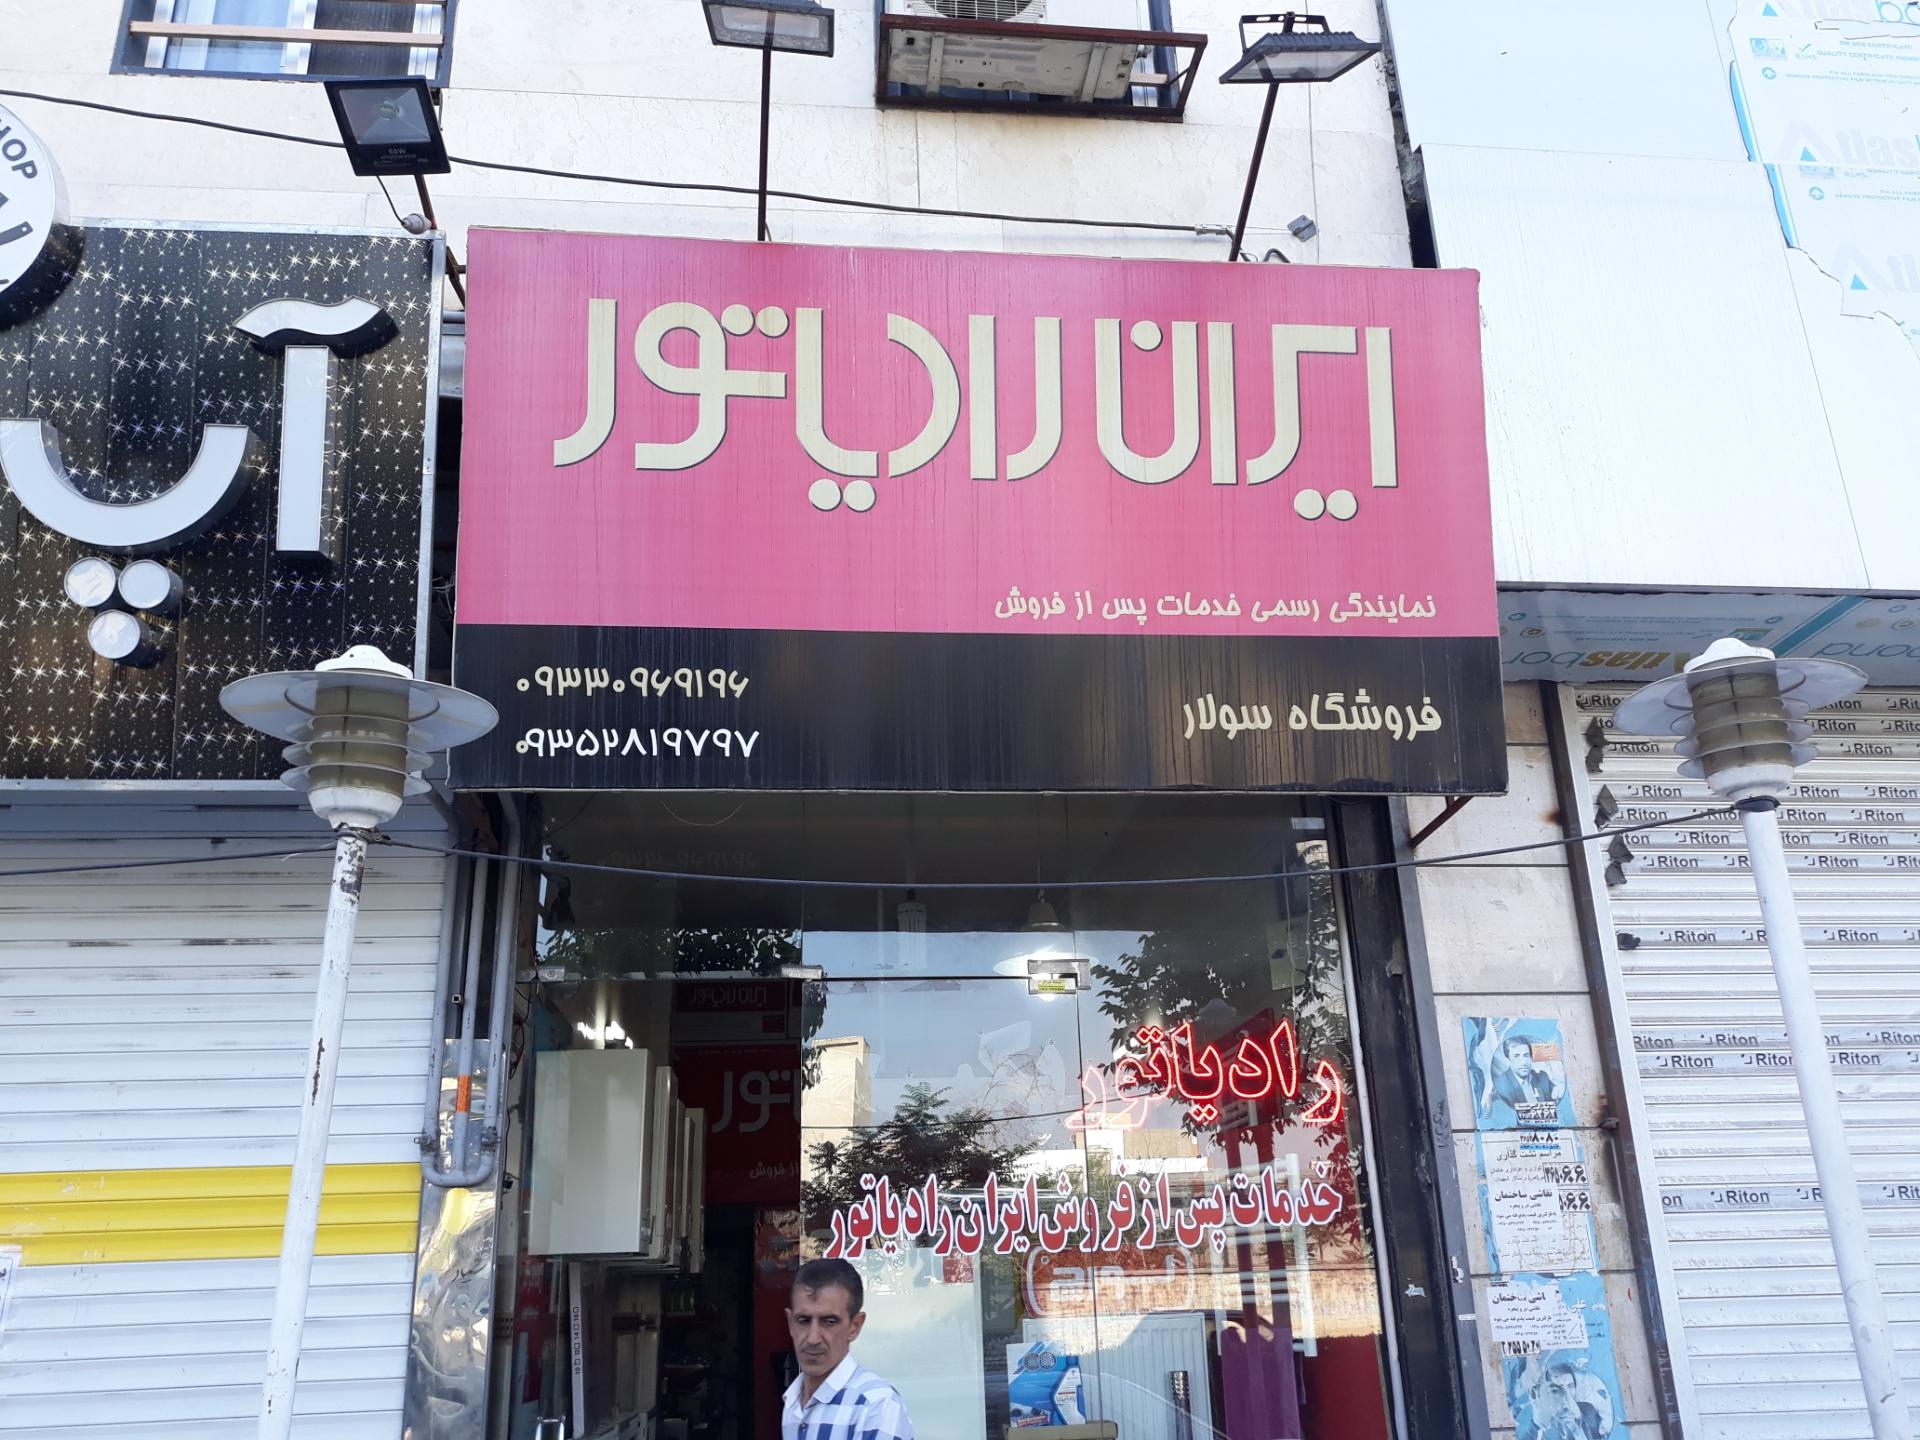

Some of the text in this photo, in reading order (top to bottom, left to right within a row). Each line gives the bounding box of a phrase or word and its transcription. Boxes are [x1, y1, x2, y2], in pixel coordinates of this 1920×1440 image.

[554, 298, 1398, 520] ایران رادیاتور
[994, 586, 1436, 626] نمایندگی رسمی خدمات پس از فروش
[516, 666, 750, 698] ۰۹۳۳۰۹۶۹۱۹۶
[1183, 688, 1442, 740] فروشگاه سولار
[1591, 695, 1622, 707] Rito
[1818, 719, 1857, 731] Riton
[515, 728, 760, 757] ۰۹۳۵۲۸۱۹۷۹۷
[1853, 743, 1893, 755] Riton
[1642, 785, 1918, 798] Riton Riton Riton
[1627, 808, 1668, 821] Riton
[1787, 809, 1827, 821] Riton
[1864, 809, 1905, 821] Riton
[1689, 831, 1730, 844] Riton
[1782, 832, 1810, 844] iton
[1849, 832, 1889, 845] Riton
[1657, 856, 1699, 868] Riton
[1819, 856, 1859, 868] Riton
[1674, 930, 1879, 943] Riton Riton
[1715, 1034, 1759, 1047] Riton
[1064, 1020, 1343, 1128] رادیاتور
[1671, 1054, 1714, 1068] Riton
[1838, 1052, 1881, 1066] Riton
[1039, 1162, 1135, 1253] فروش
[1137, 1166, 1171, 1249] از
[1230, 1162, 1343, 1227] خدمات
[1726, 1189, 1770, 1205] Riton
[825, 1173, 953, 1259] رادیاتور
[955, 1171, 1040, 1255] ایران
[1175, 1184, 1227, 1254] پس
